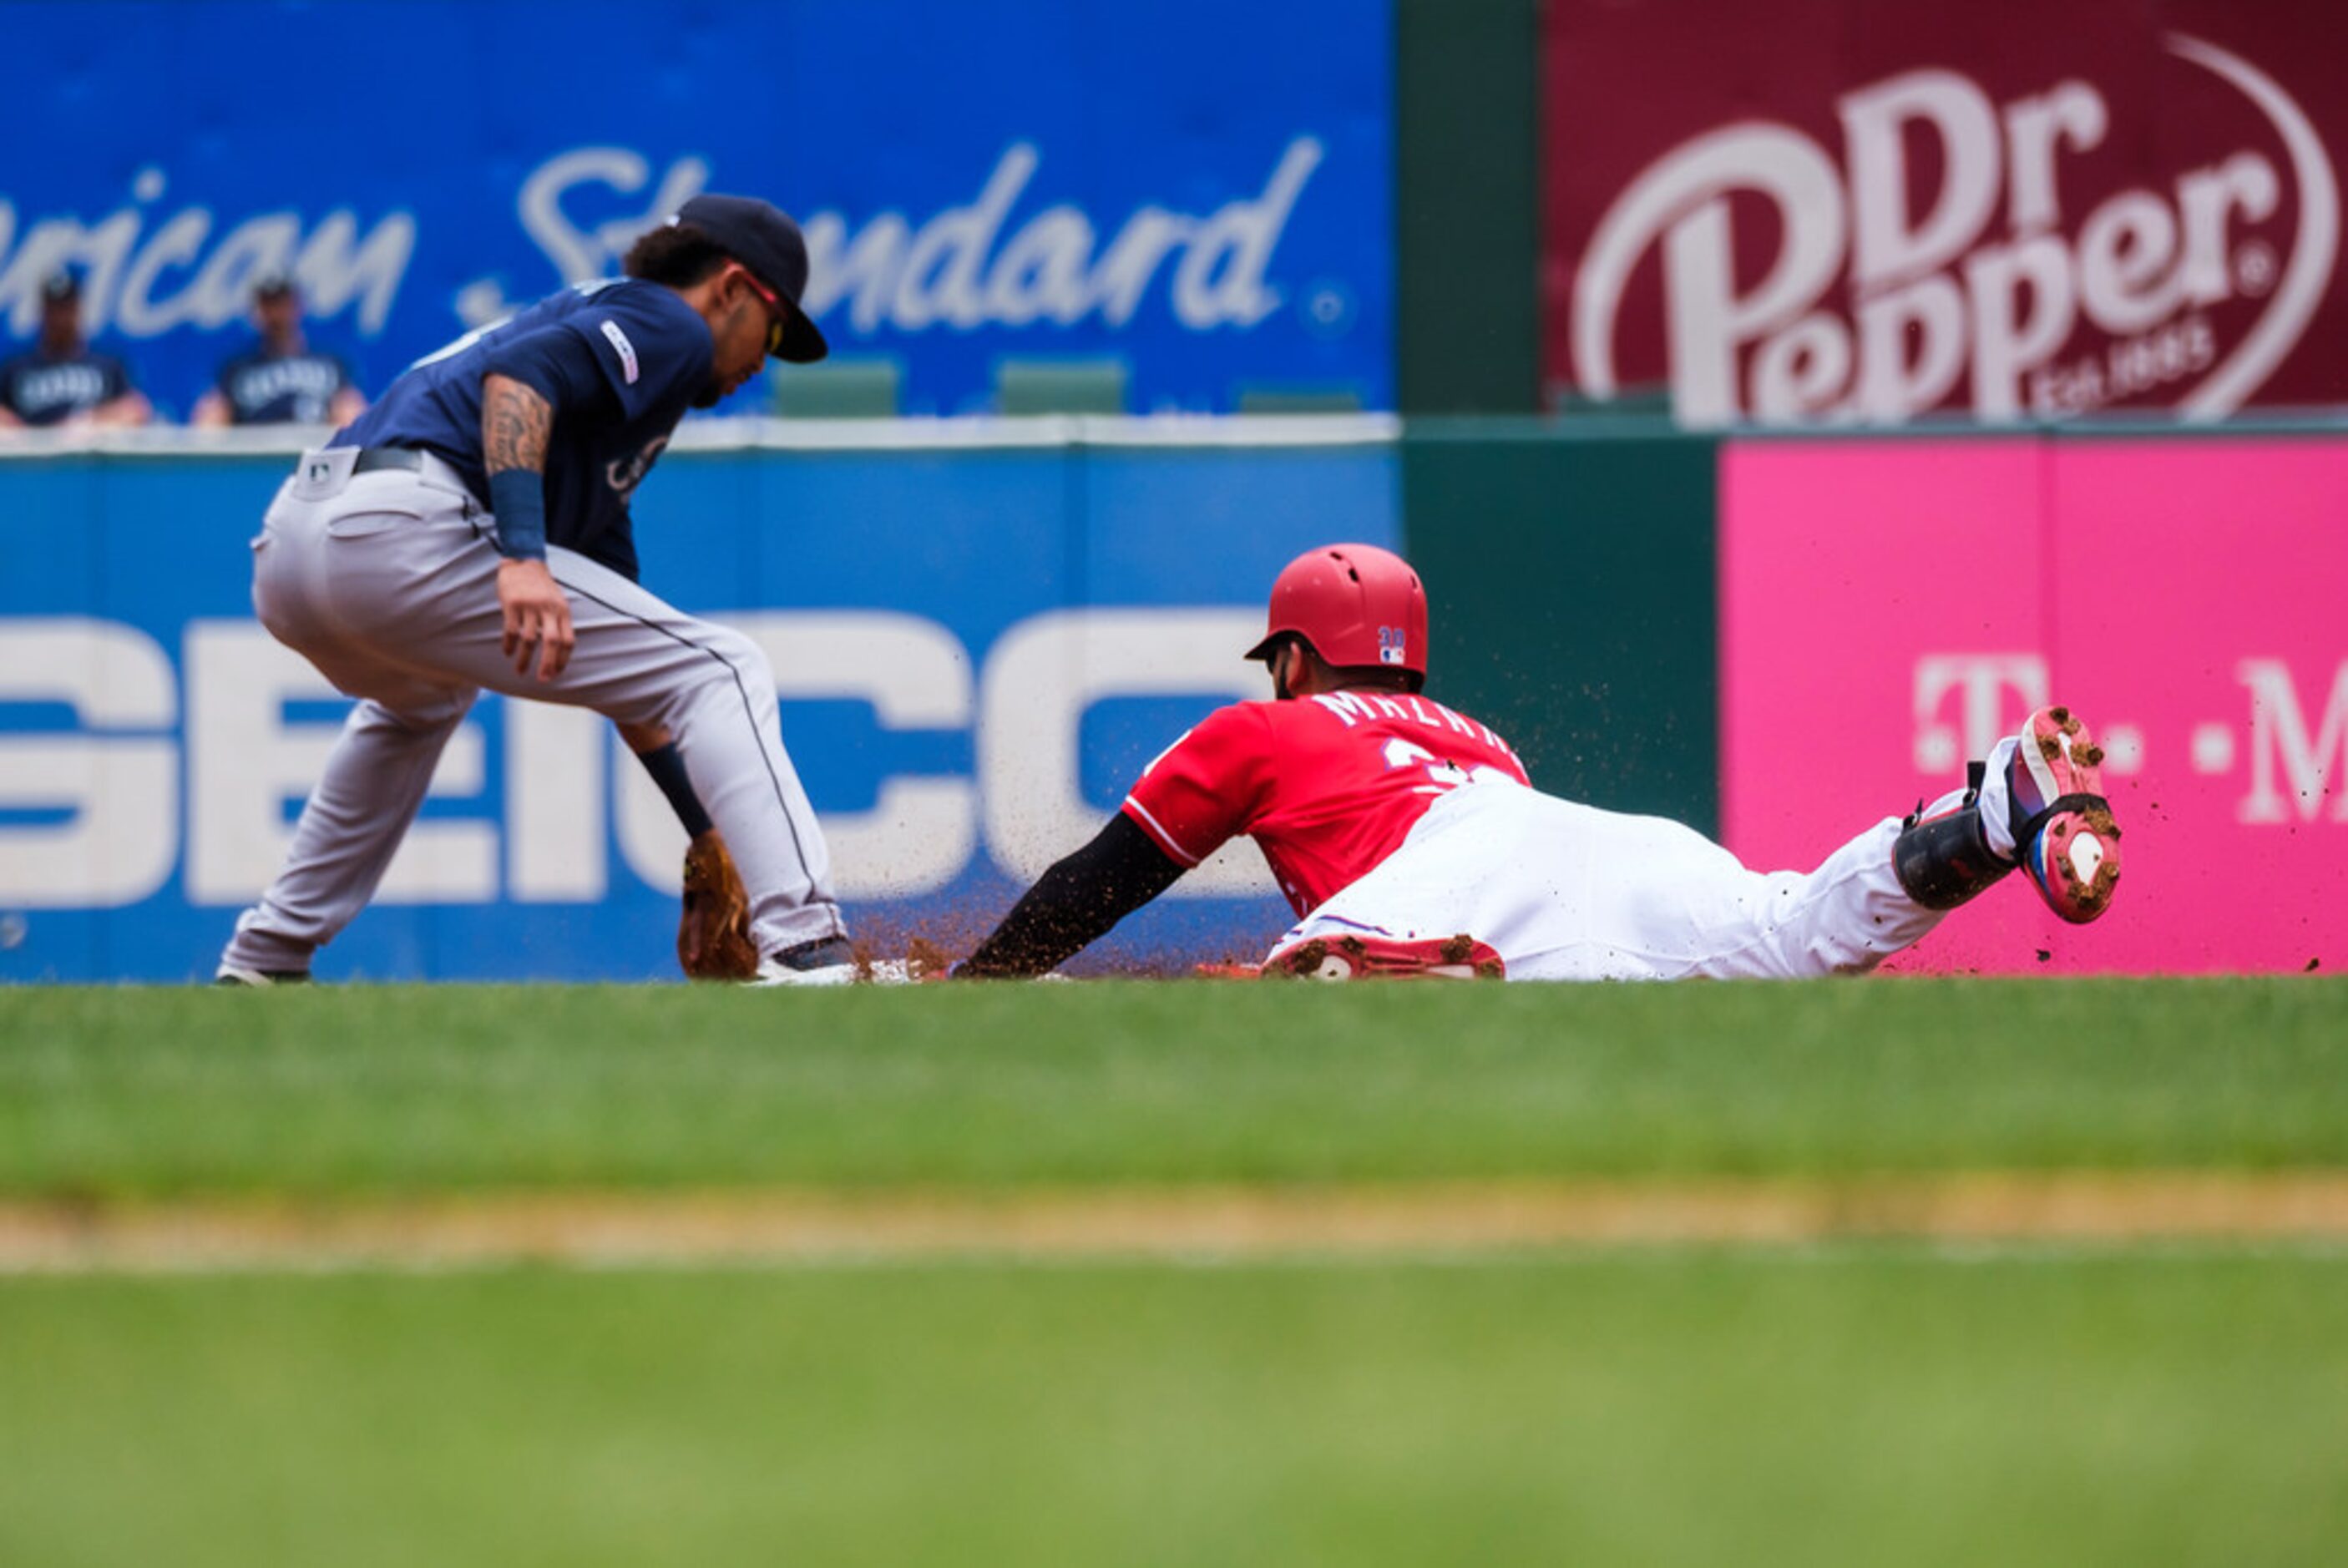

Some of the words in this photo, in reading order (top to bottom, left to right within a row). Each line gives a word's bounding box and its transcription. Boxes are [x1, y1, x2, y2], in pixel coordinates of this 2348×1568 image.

[0, 169, 416, 337] rican
[1839, 67, 2106, 286] Dr
[1571, 119, 2280, 429] Pepper
[1378, 625, 1405, 648] 30
